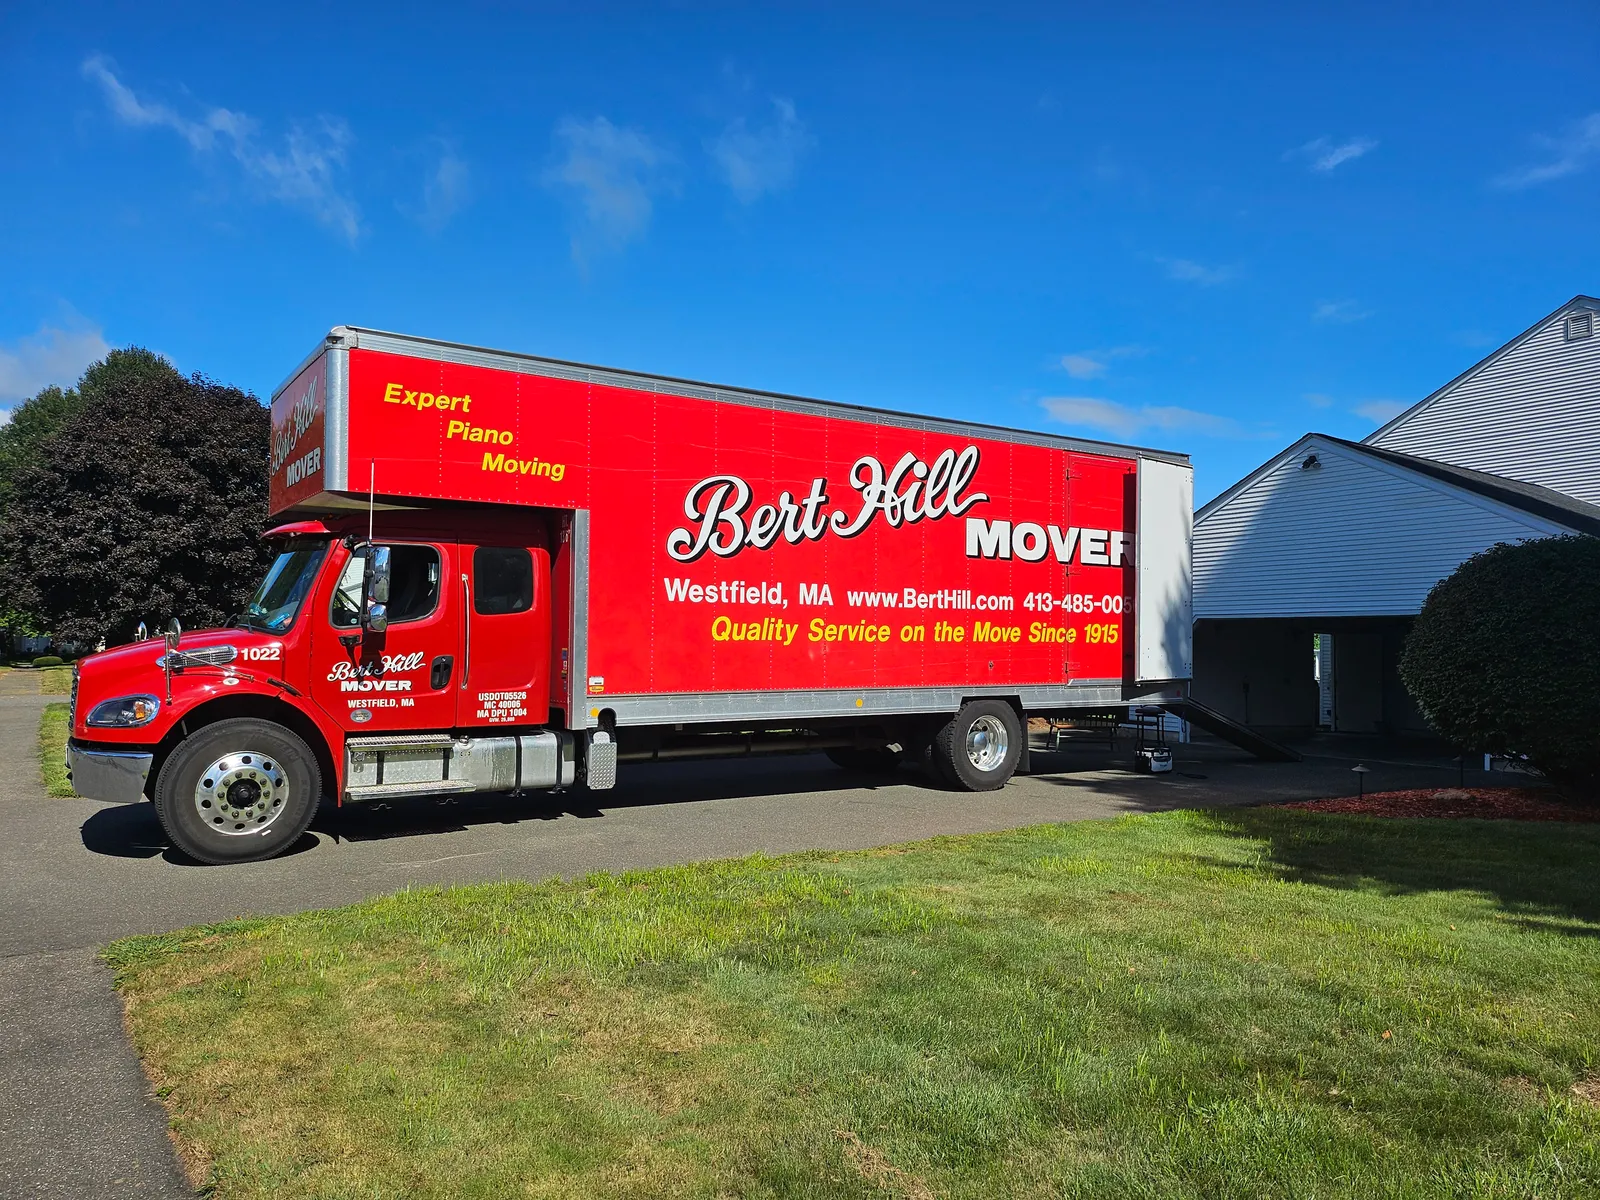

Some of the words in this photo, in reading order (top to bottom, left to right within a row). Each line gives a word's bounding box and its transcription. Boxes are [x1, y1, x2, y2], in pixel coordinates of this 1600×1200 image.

[384, 382, 472, 413] Expert
[446, 420, 514, 446] Piano
[286, 446, 321, 488] MOVER
[481, 453, 566, 482] Moving
[666, 474, 829, 563] Bert
[830, 445, 990, 538] Hill
[965, 517, 1136, 568] MOVER
[664, 577, 788, 608] Westfield,
[799, 583, 834, 605] MA
[847, 587, 1014, 611] www.BertHill.com
[1023, 592, 1135, 614] 413-485-005
[711, 616, 798, 645] Quality
[808, 618, 890, 642] Service
[900, 624, 925, 642] on
[934, 621, 965, 642] the
[973, 622, 1021, 643] Move
[1028, 622, 1076, 643] Since
[1084, 623, 1118, 644] 1915
[241, 648, 280, 661] 1022
[327, 661, 373, 681] Bert
[374, 651, 426, 674] Hill
[340, 680, 412, 692] MOVER
[478, 692, 527, 701] USDOT05526
[347, 699, 399, 708] WESTFIELD,
[401, 698, 415, 706] MA
[477, 709, 489, 718] MA
[491, 709, 507, 717] DPU
[509, 708, 527, 716] 1004
[484, 701, 496, 709] MC
